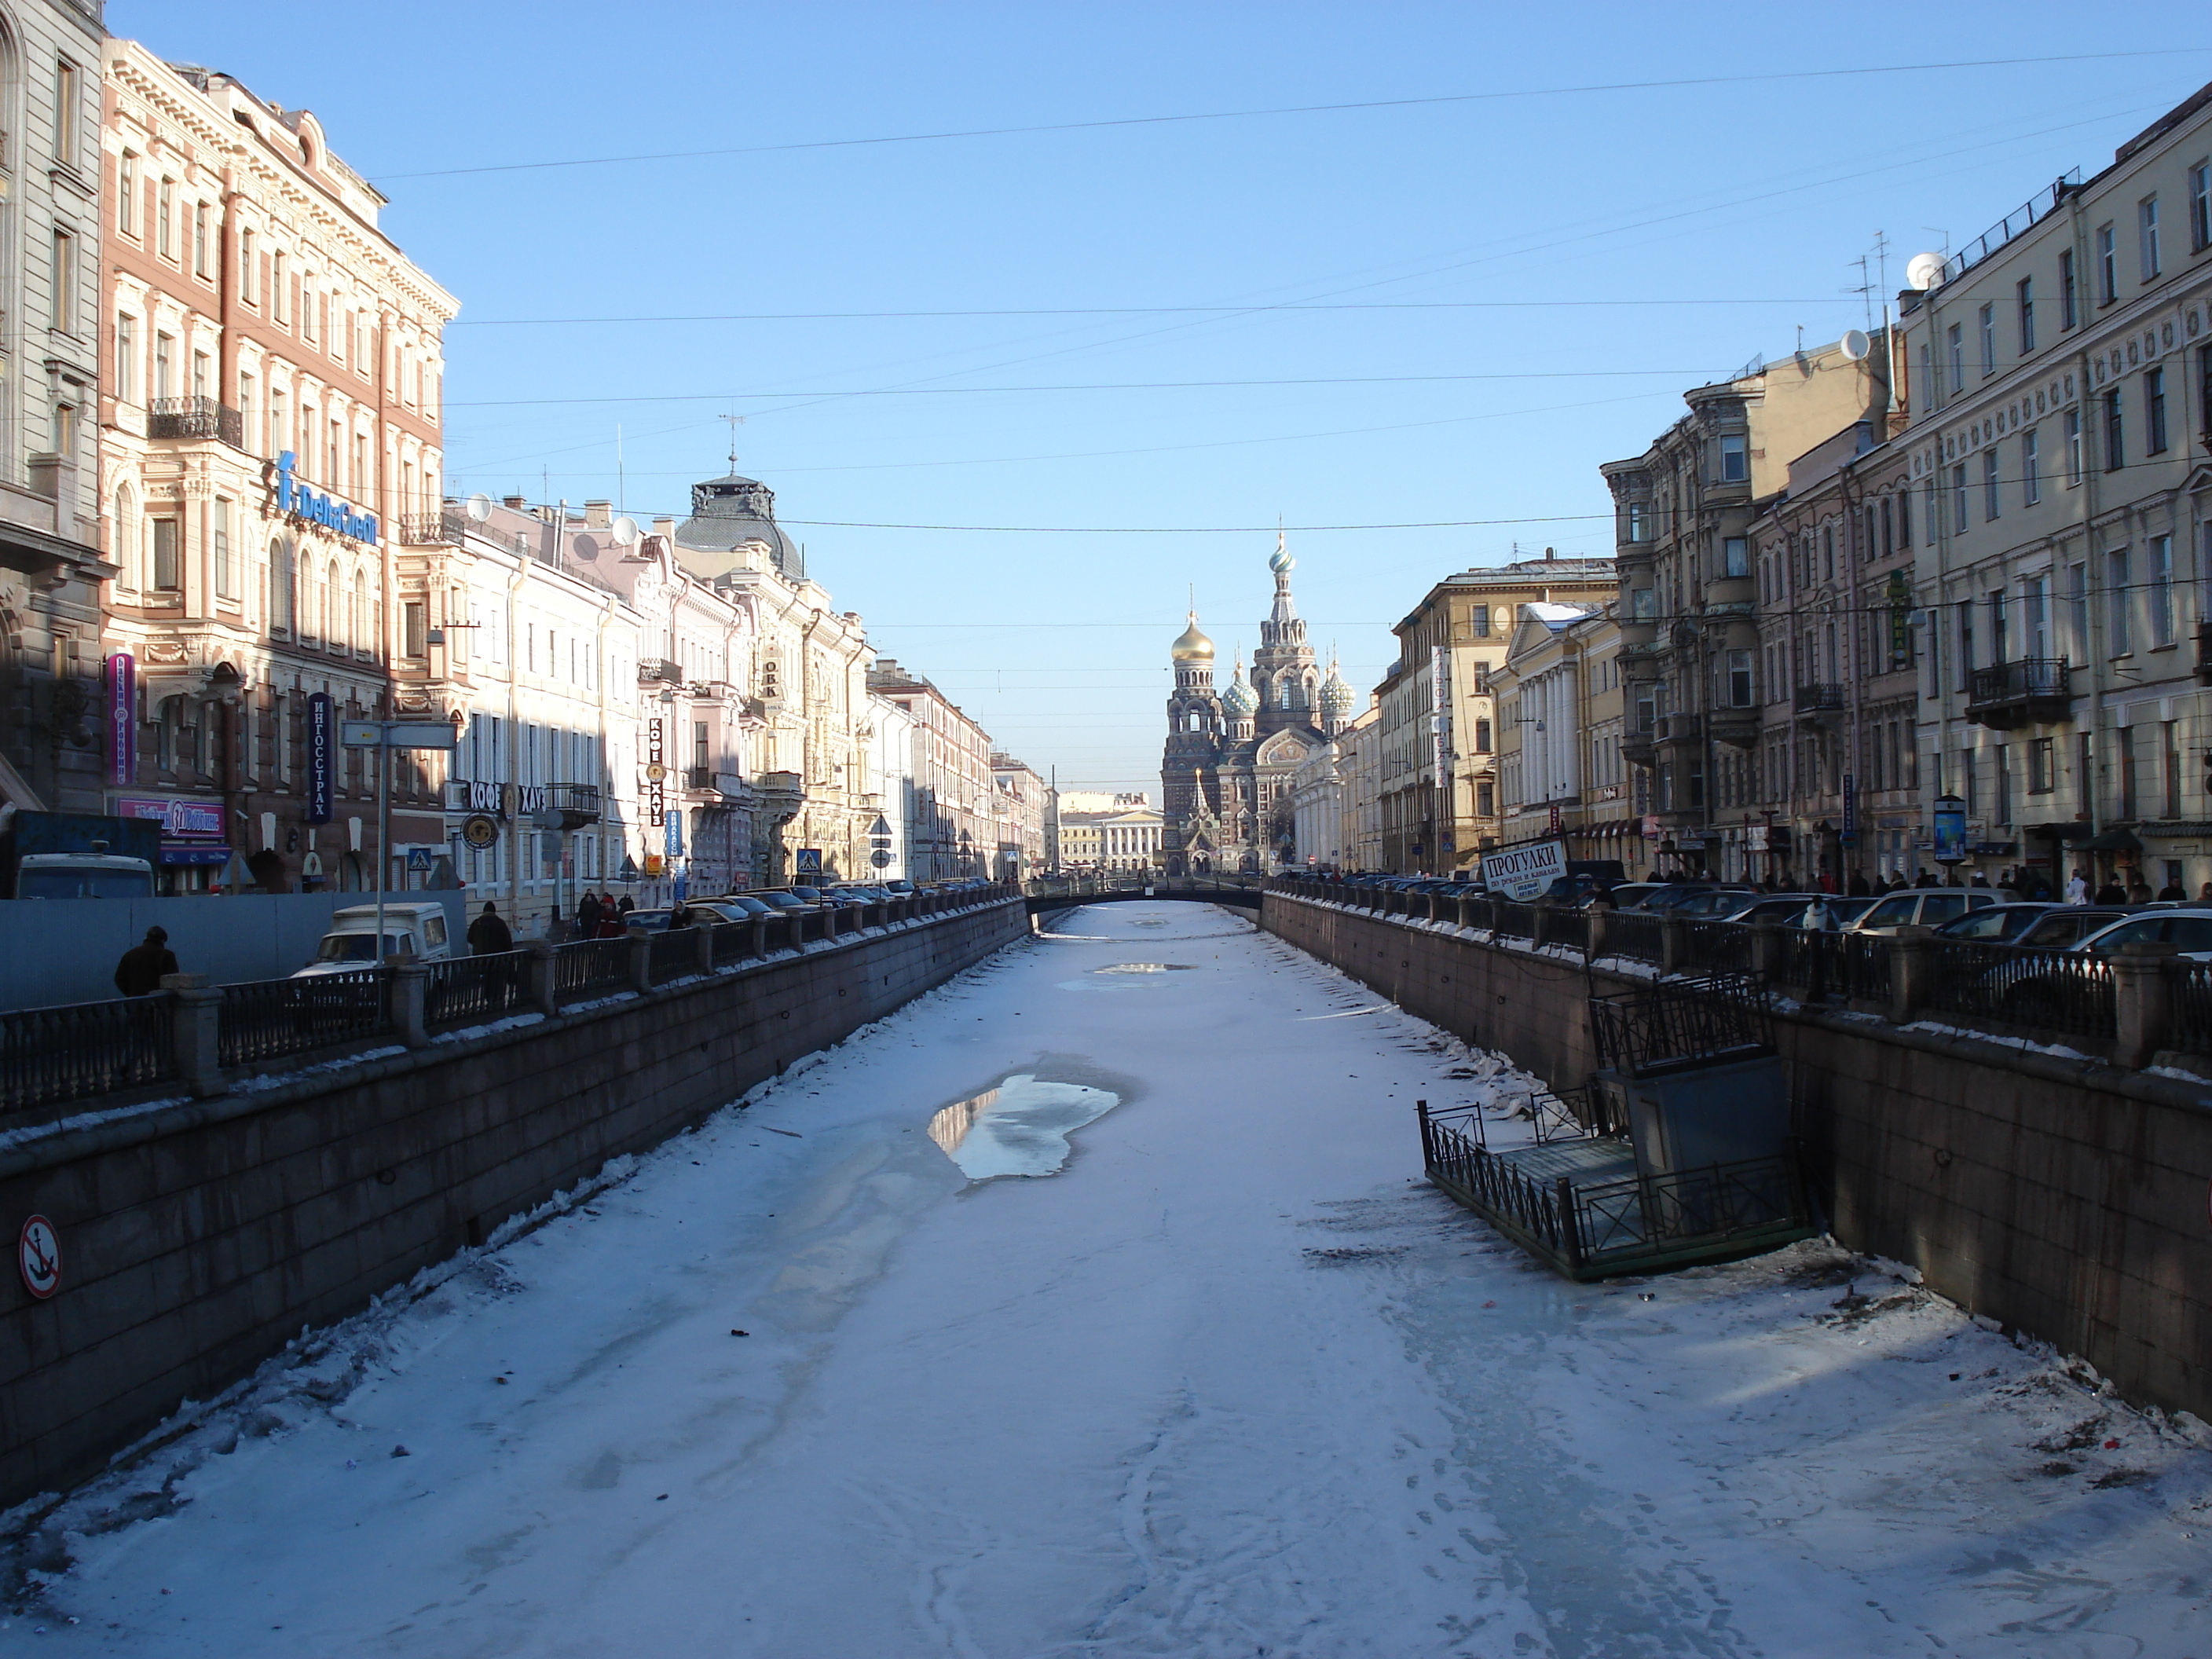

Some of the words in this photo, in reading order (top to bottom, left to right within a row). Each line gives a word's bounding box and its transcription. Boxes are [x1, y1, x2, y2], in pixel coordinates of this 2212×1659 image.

[298, 484, 377, 546] DeltaCredit
[1434, 648, 1445, 711] АЛЬФА
[314, 701, 325, 815] ИНГОССТРАХ
[650, 719, 661, 761] КОФЕ
[1437, 738, 1445, 786] БАНК
[471, 782, 501, 811] КОФЕ
[522, 786, 547, 812] ХАУЗ
[651, 783, 662, 826] ХАУЗ
[1486, 845, 1558, 878] ПРОГУЛКИ
[1501, 875, 1522, 888] рекам
[1531, 867, 1560, 878] каналам
